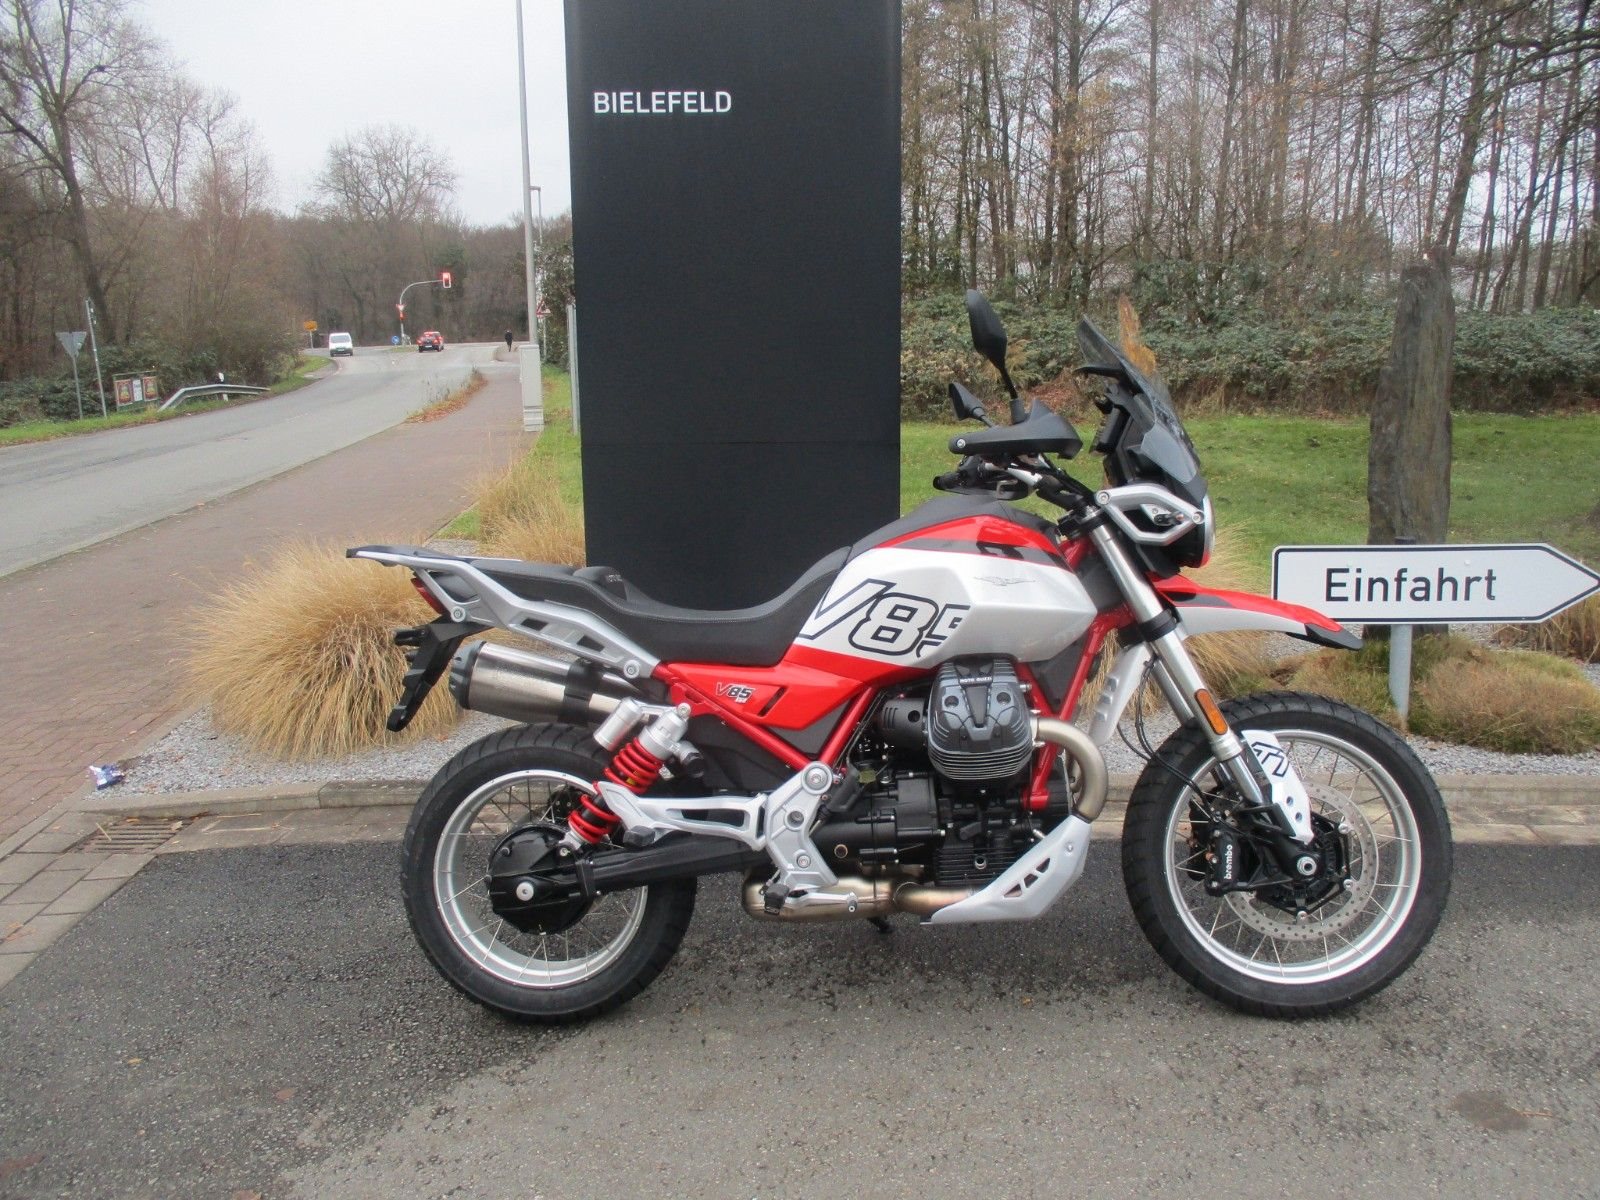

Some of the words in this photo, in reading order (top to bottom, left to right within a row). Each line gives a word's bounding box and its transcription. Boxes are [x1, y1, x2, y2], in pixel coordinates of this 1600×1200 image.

[593, 91, 732, 113] BIELEFELD
[1325, 567, 1497, 602] Einfahrt
[714, 682, 756, 699] V85
[1223, 844, 1233, 880] brembo
